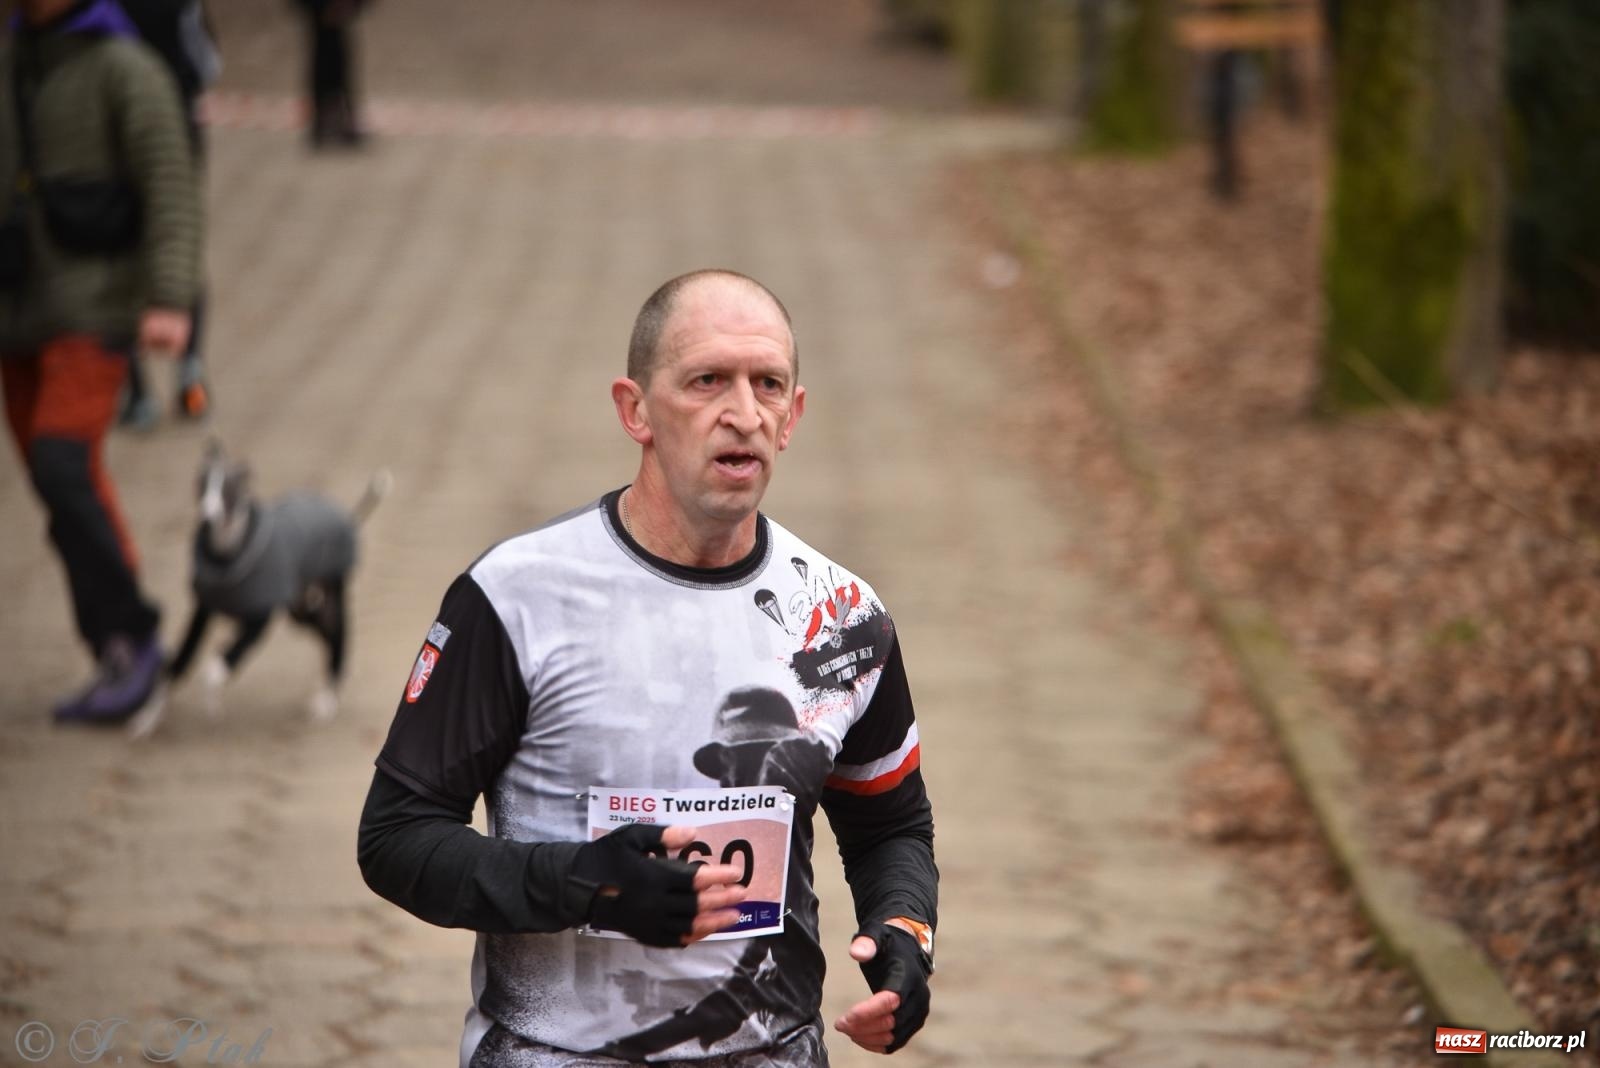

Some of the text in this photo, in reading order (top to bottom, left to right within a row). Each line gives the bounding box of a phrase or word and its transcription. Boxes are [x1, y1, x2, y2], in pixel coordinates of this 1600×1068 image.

[609, 793, 776, 812] BIEG Twardziela
[619, 815, 635, 823] luty
[650, 839, 754, 889] 60
